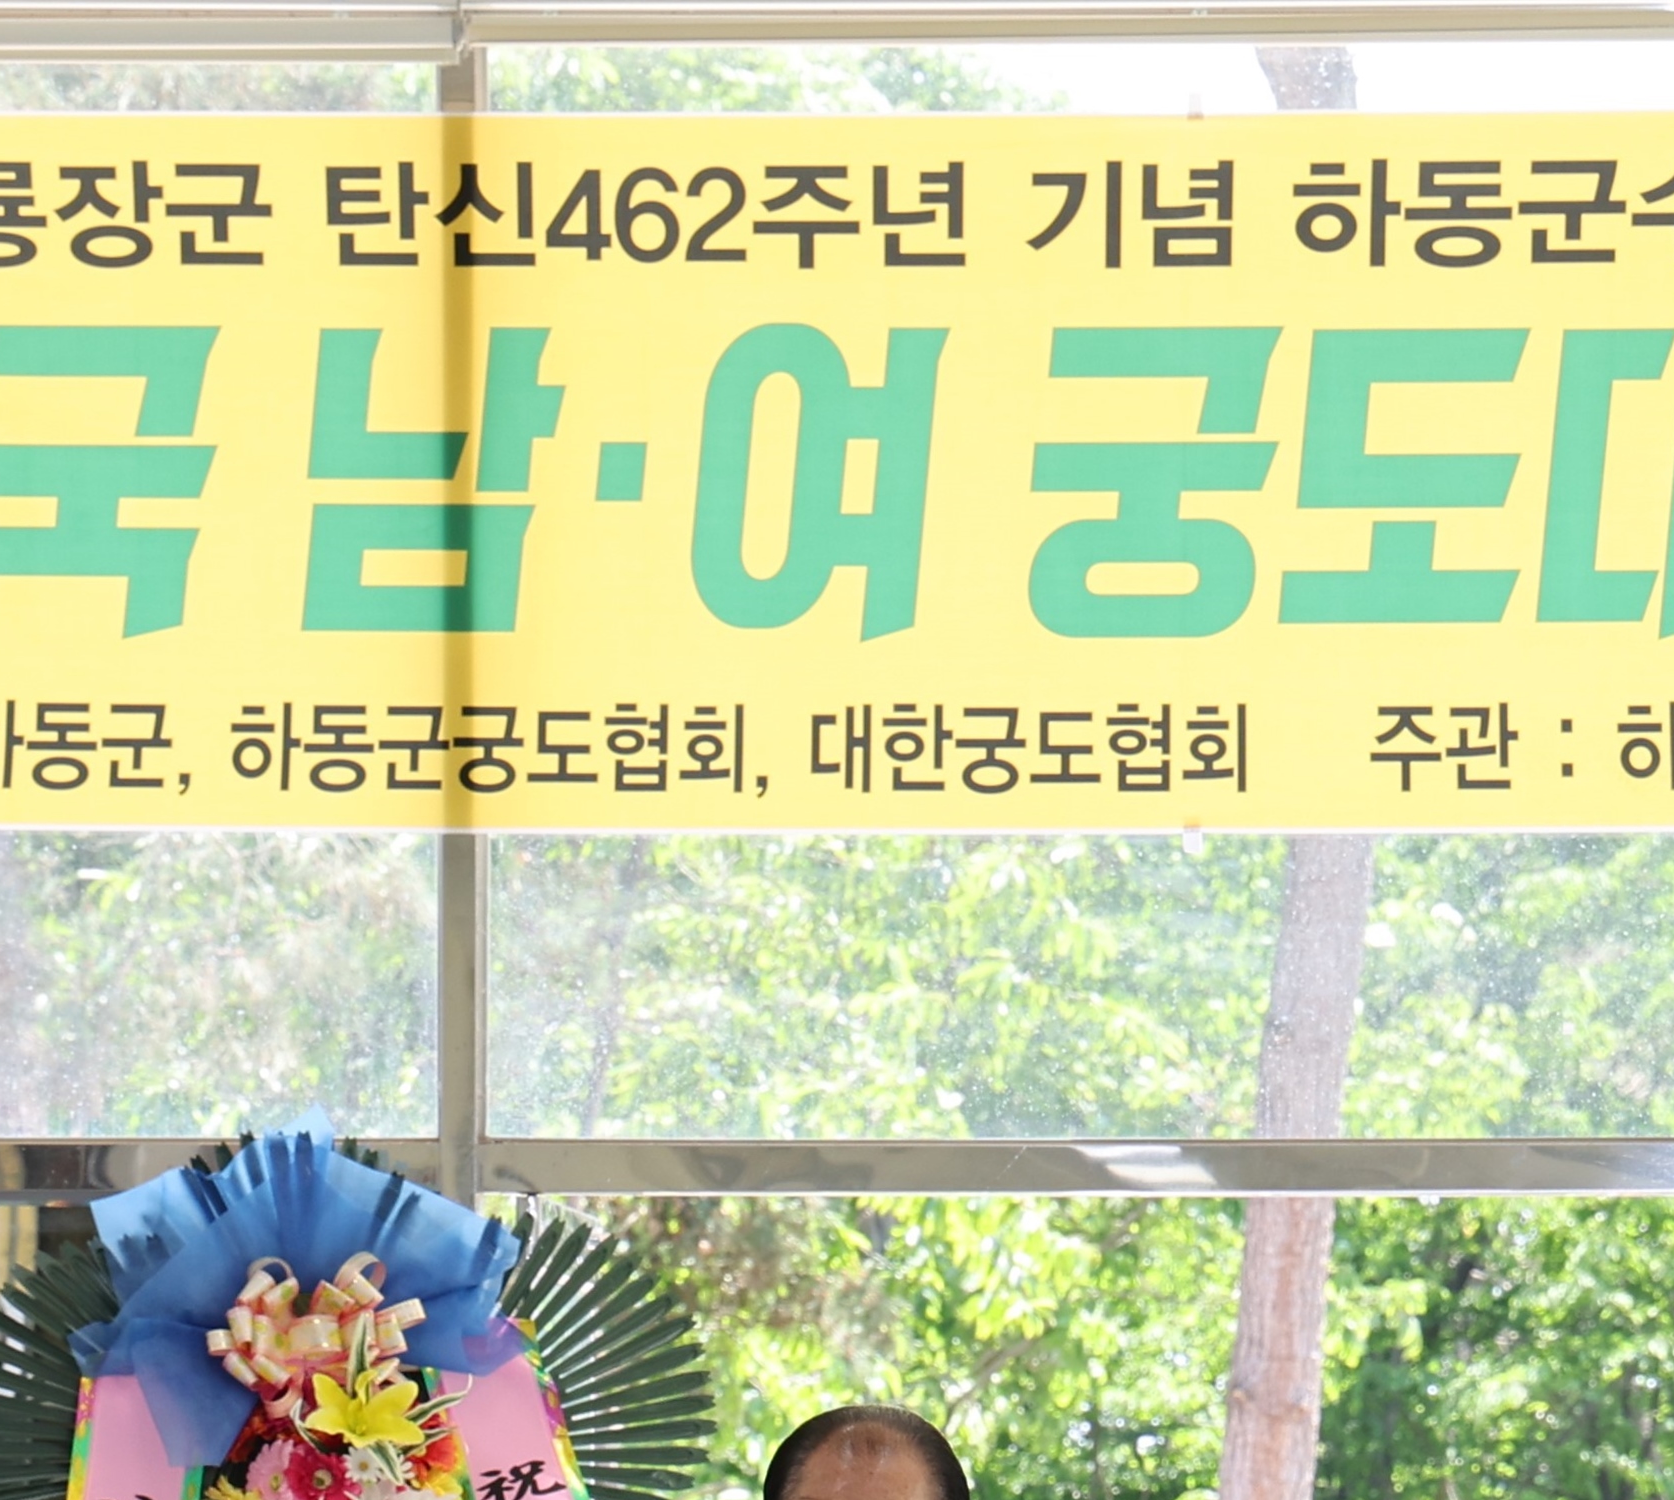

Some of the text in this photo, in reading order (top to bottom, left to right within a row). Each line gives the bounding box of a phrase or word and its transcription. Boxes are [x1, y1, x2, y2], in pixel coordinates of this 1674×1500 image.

[325, 161, 966, 270] 탄신462주년
[1028, 160, 1234, 270] 기념
[230, 703, 769, 797] 하동군궁도협회,
[810, 703, 1249, 795] 대한궁도협회
[1369, 703, 1520, 793] 주관
